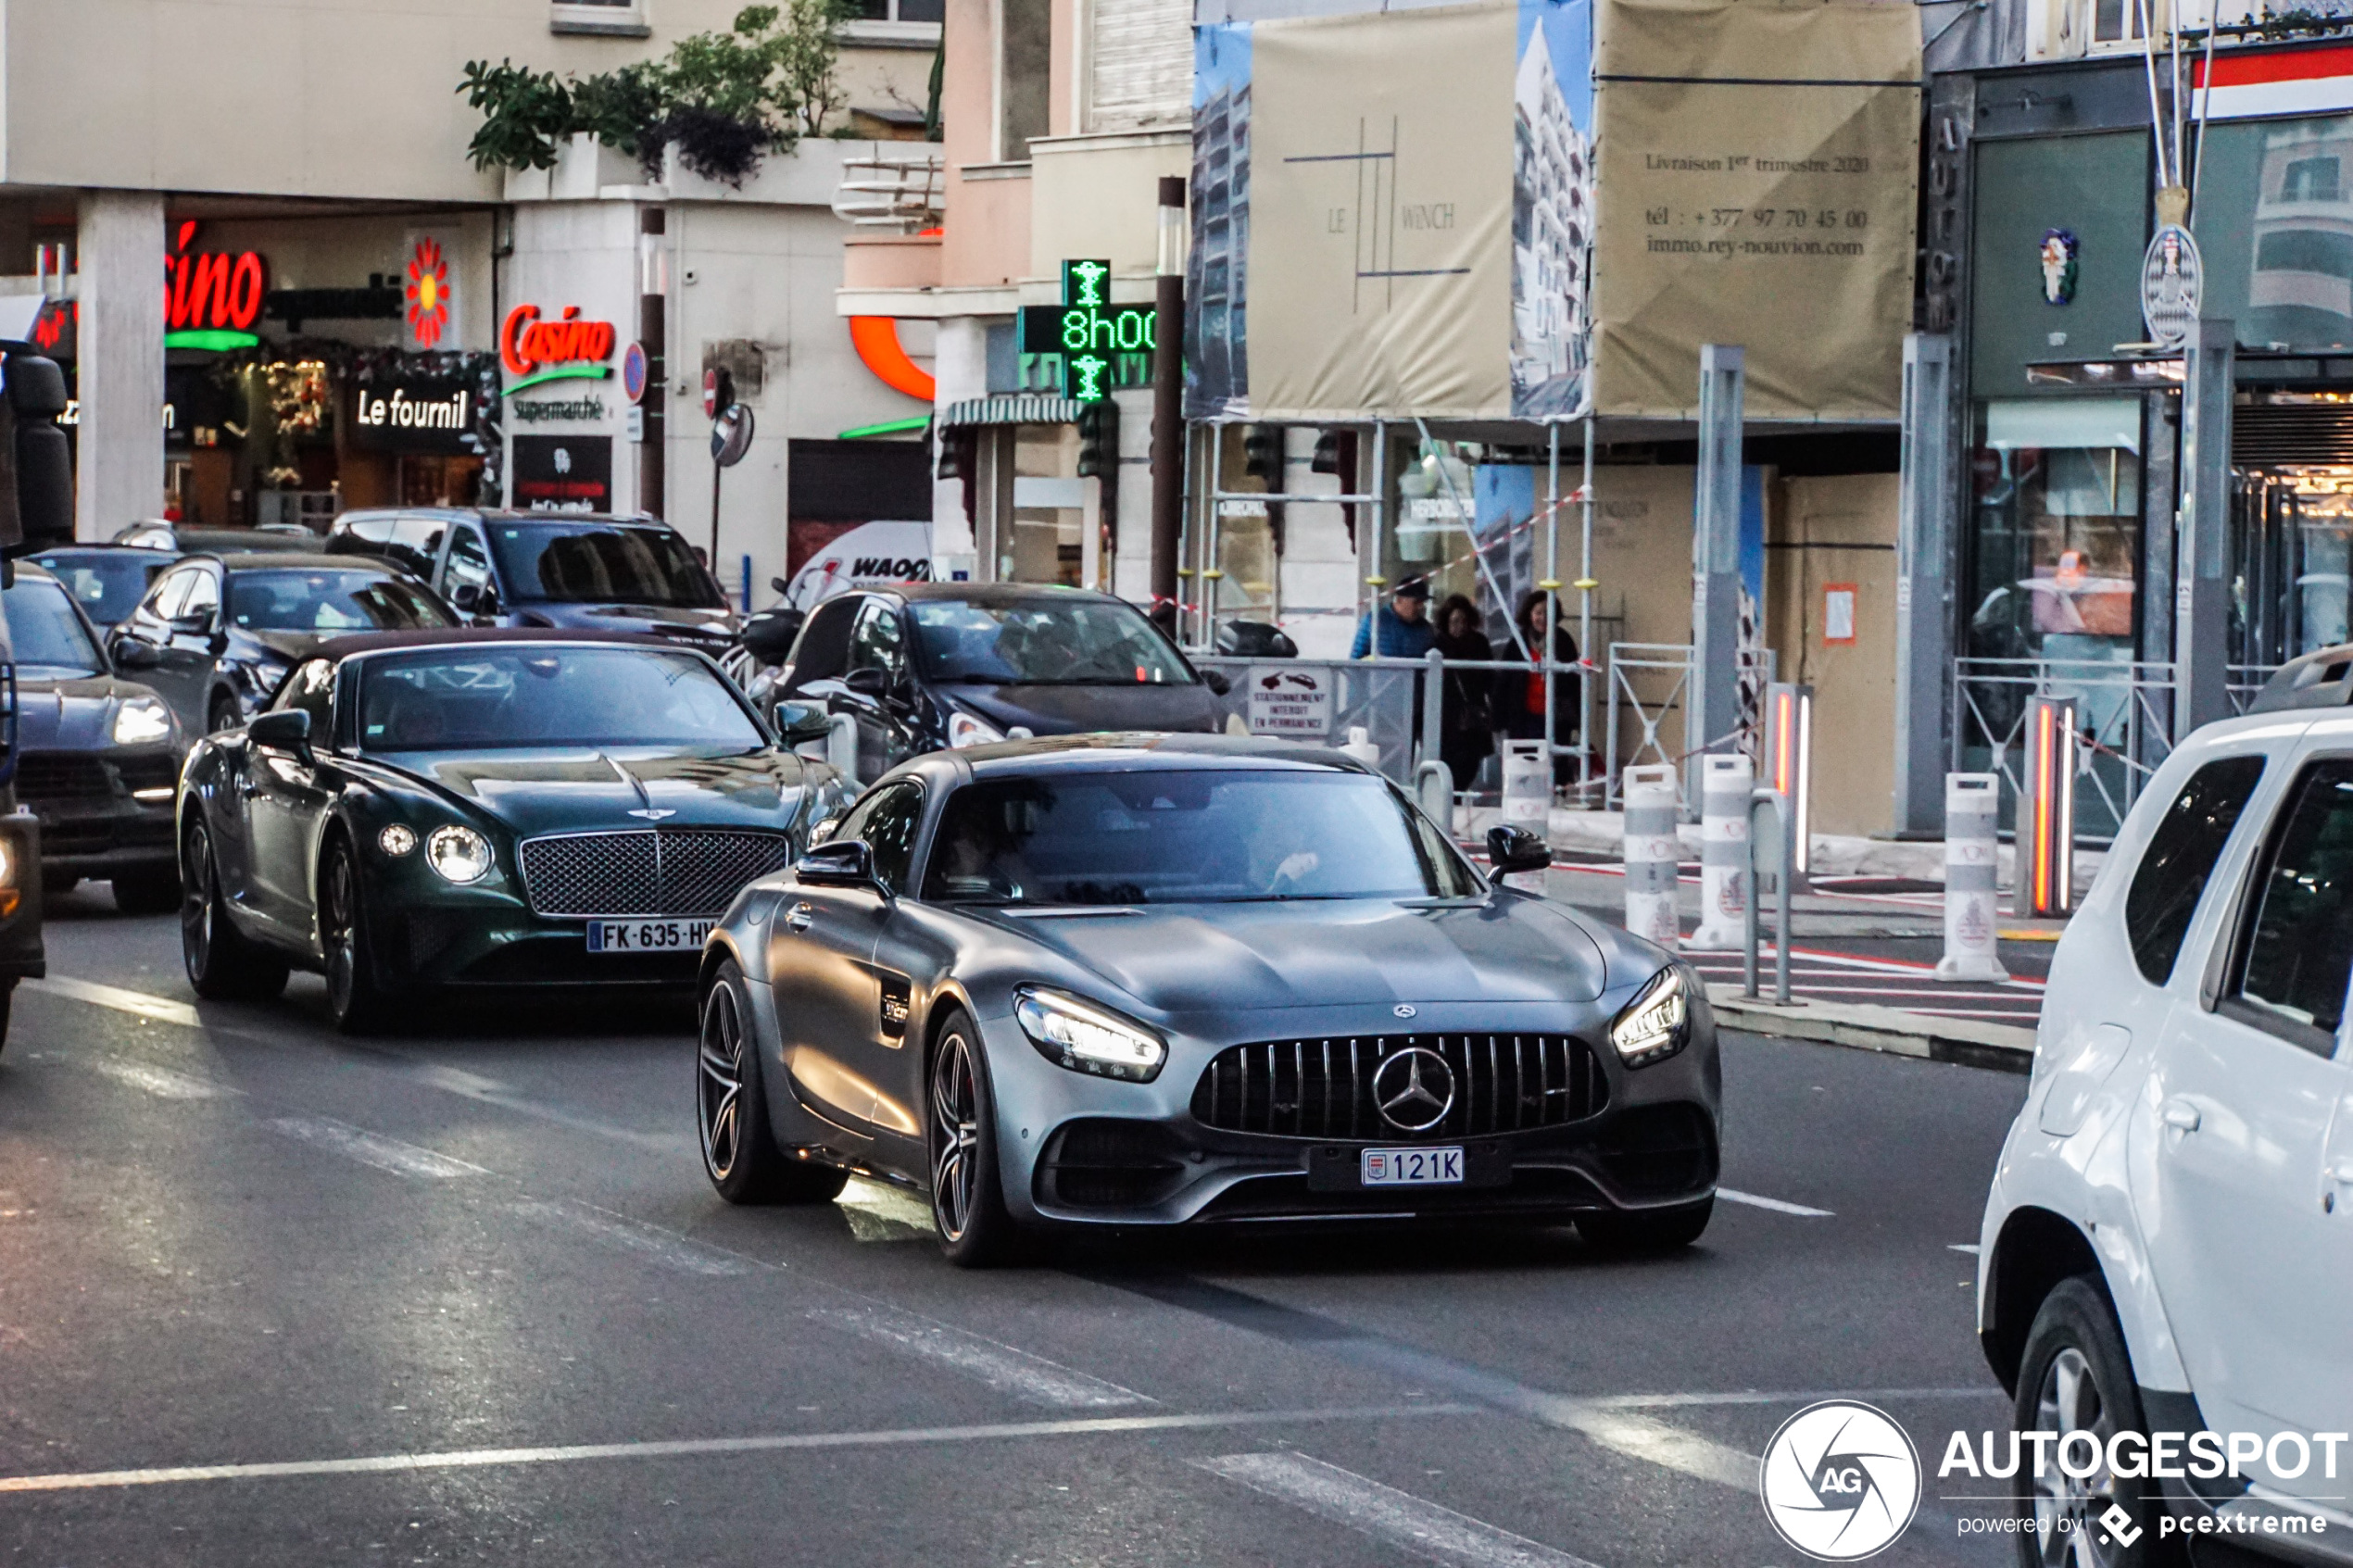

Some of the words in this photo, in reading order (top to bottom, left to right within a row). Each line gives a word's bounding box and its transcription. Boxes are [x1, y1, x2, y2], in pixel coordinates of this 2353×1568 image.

[1646, 154, 1721, 170] Livraison
[1755, 157, 1830, 172] trimestre
[1833, 157, 1869, 173] 2020
[1328, 207, 1346, 233] LE
[1646, 207, 1668, 225] tél
[1711, 208, 1743, 226] 377
[1754, 209, 1776, 227] 97
[1785, 209, 1806, 228] 70
[1816, 209, 1837, 228] 45
[1844, 210, 1869, 229] 00
[1647, 235, 1864, 259] immo.rey-nouvion.com
[501, 302, 615, 374] Casino
[358, 389, 386, 425] Le
[390, 388, 468, 428] fournil
[513, 395, 604, 423] supermarché
[1254, 692, 1326, 702] STATIONNEMENT
[1270, 705, 1308, 714] INTERDIT
[1254, 718, 1265, 727] EN
[1268, 718, 1322, 728] PERMANENCE
[1394, 1152, 1458, 1179] 121K
